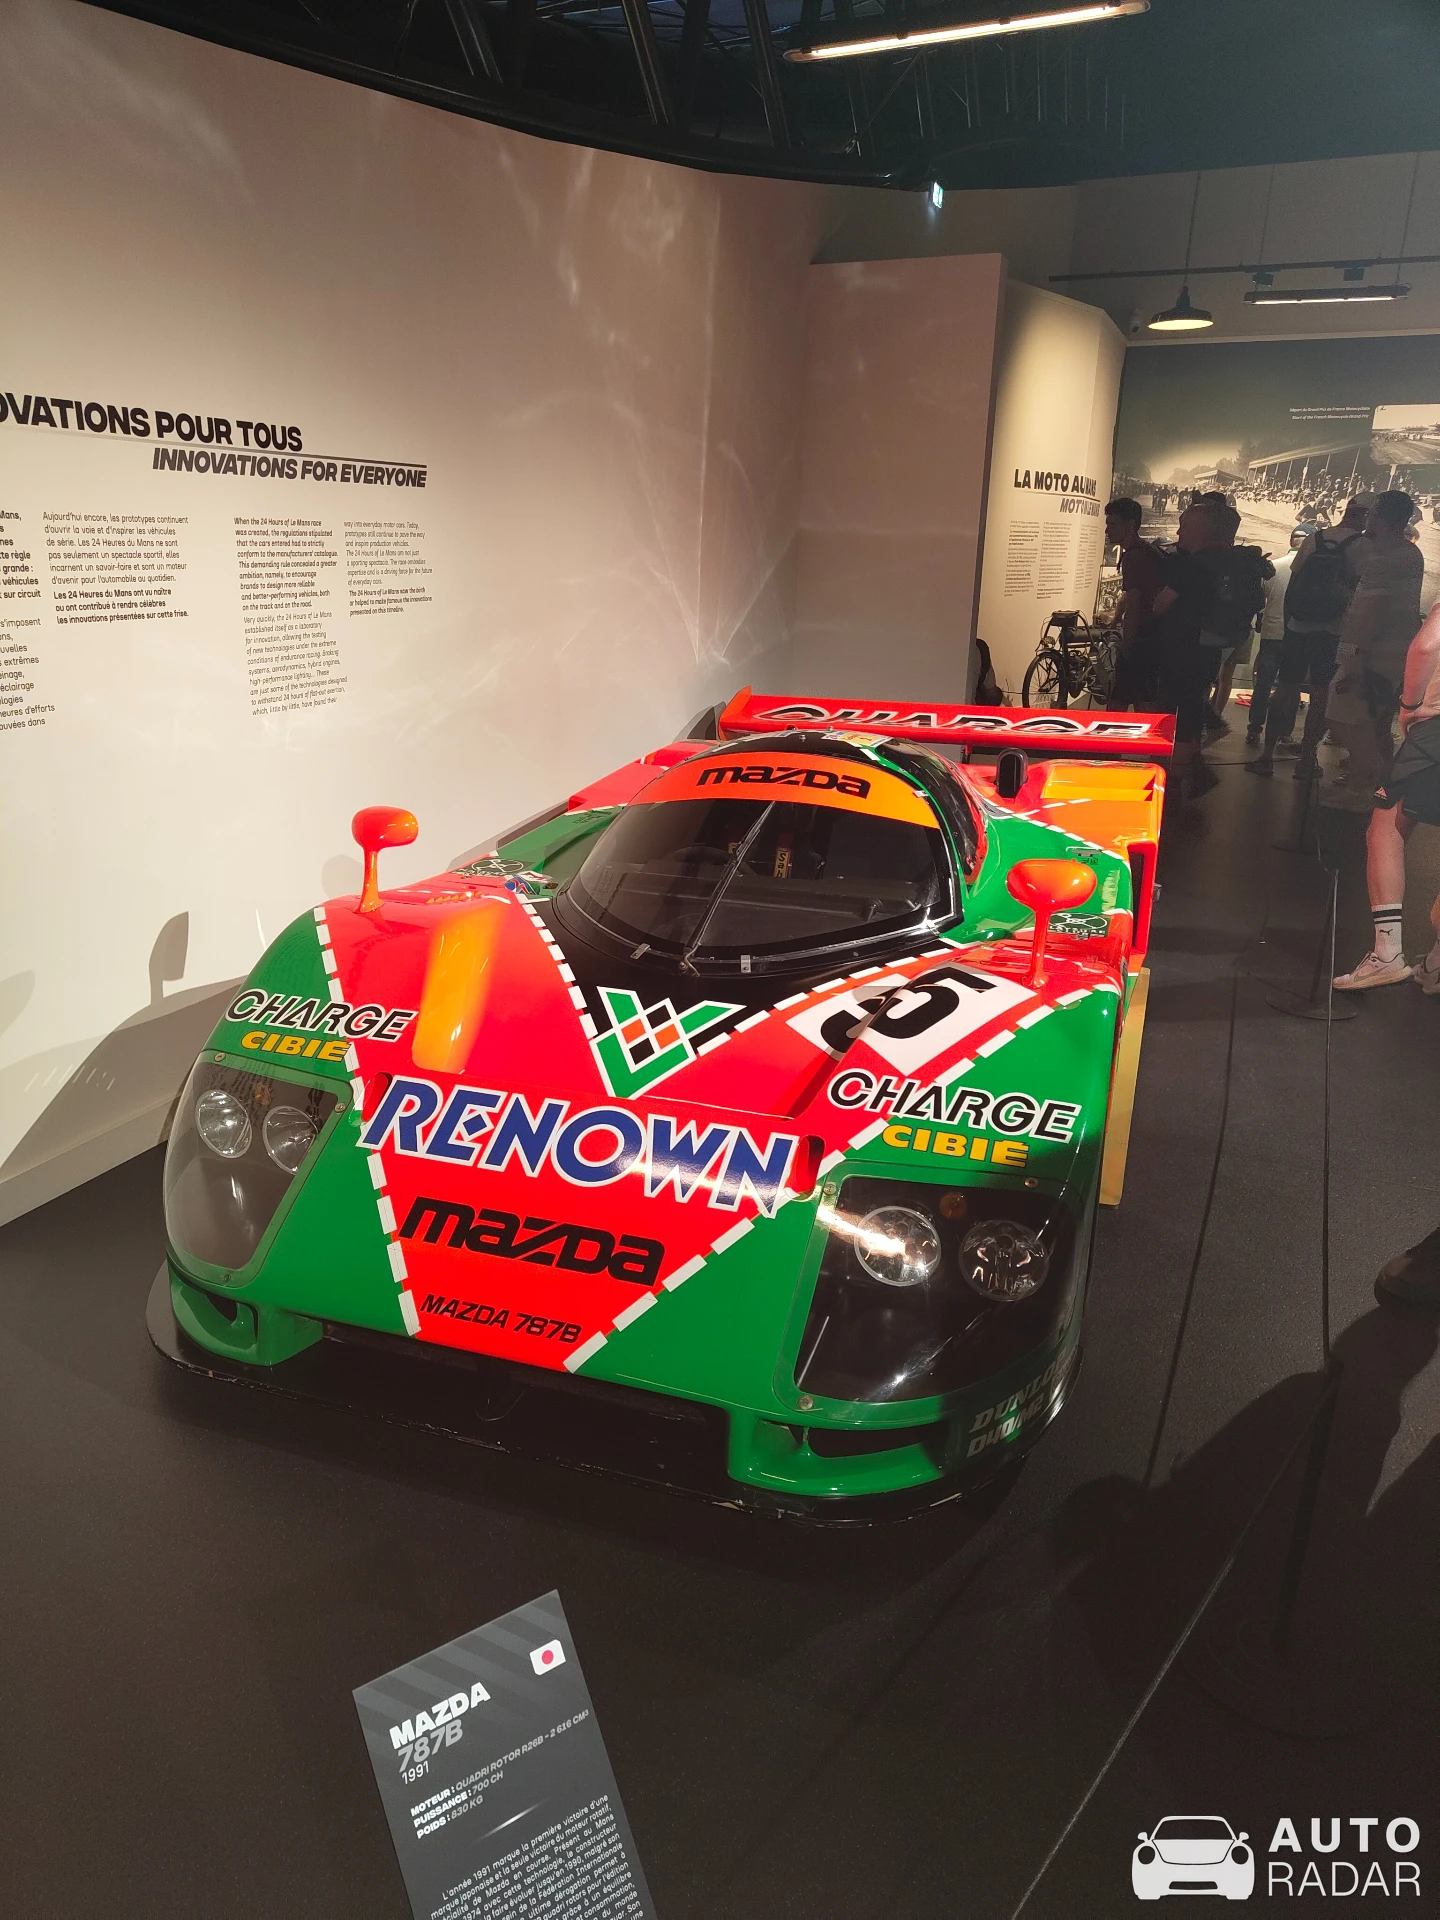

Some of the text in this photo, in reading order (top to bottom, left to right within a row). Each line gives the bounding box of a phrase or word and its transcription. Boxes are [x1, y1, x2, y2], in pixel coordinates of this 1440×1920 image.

[155, 411, 233, 445] POUR
[236, 420, 302, 452] TOUS
[152, 448, 427, 488] INNOVATIONS FOR EVERYONE
[1014, 468, 1031, 489] LA
[1034, 471, 1069, 492] MOTO
[42, 511, 82, 522] Aujourd'hui
[83, 514, 108, 523] encore,
[109, 513, 120, 522] les
[121, 515, 155, 524] prototypes
[44, 524, 70, 533] d'ouvrir
[72, 524, 79, 534] la
[105, 525, 134, 536] d'inspirer
[147, 526, 176, 535] véhicules
[46, 537, 55, 546] de
[56, 537, 76, 546] série.
[77, 538, 90, 546] Les
[91, 537, 100, 546] 24
[126, 538, 135, 546] du
[136, 538, 154, 546] Mans
[10, 549, 30, 561] règle
[48, 552, 61, 561] pas
[62, 550, 99, 559] seulement
[111, 550, 141, 560] spectacle
[143, 550, 164, 559] sportif,
[165, 550, 179, 558] elles
[2, 563, 29, 575] grande
[95, 562, 131, 571] savoir-faire
[2, 576, 38, 585] véhicules
[51, 575, 78, 584] d'avenir
[80, 576, 96, 586] pour
[97, 574, 136, 583] l'automobile
[147, 573, 176, 583] quotidien.
[17, 588, 41, 598] circuit
[53, 591, 67, 599] Les
[67, 590, 77, 599] 24
[78, 590, 103, 598] Heures
[104, 589, 112, 597] du
[113, 589, 132, 597] Mans
[153, 587, 171, 595] naître
[78, 601, 110, 610] contribué
[116, 600, 138, 608] rendre
[139, 599, 166, 608] célèbres
[0, 618, 41, 629] s'imposent
[56, 615, 68, 624] les
[68, 614, 108, 623] innovations
[109, 613, 145, 623] présentées
[3, 655, 39, 666] extrêmes
[24, 704, 55, 714] d'efforts
[27, 718, 45, 726] dans
[696, 766, 872, 799] mazda
[224, 988, 418, 1042] CHARGE
[827, 1068, 1082, 1144] CHARGE
[356, 1075, 798, 1218] RENOWN
[398, 1196, 665, 1287] mazda
[420, 1294, 583, 1344] MAZDA 787B
[389, 1682, 491, 1750] MAZDA
[397, 1719, 463, 1773] 787B
[401, 1760, 430, 1784] 1991
[410, 1788, 451, 1816] MOTEUR
[455, 1765, 489, 1790] QUADRI
[490, 1748, 520, 1772] ROTOR
[521, 1735, 543, 1754] R26B
[550, 1728, 555, 1738] 2
[556, 1719, 571, 1733] 616
[413, 1791, 468, 1827] PUISSANCE
[472, 1778, 489, 1794] 700
[490, 1770, 503, 1783] CH
[416, 1816, 446, 1838] POIDS
[451, 1802, 468, 1819] 830
[469, 1794, 483, 1808] KG
[442, 1794, 608, 1900] L'année 1991 marque la première victoire d'une
[483, 1823, 616, 1911] avec cette technologie, le constructeur
